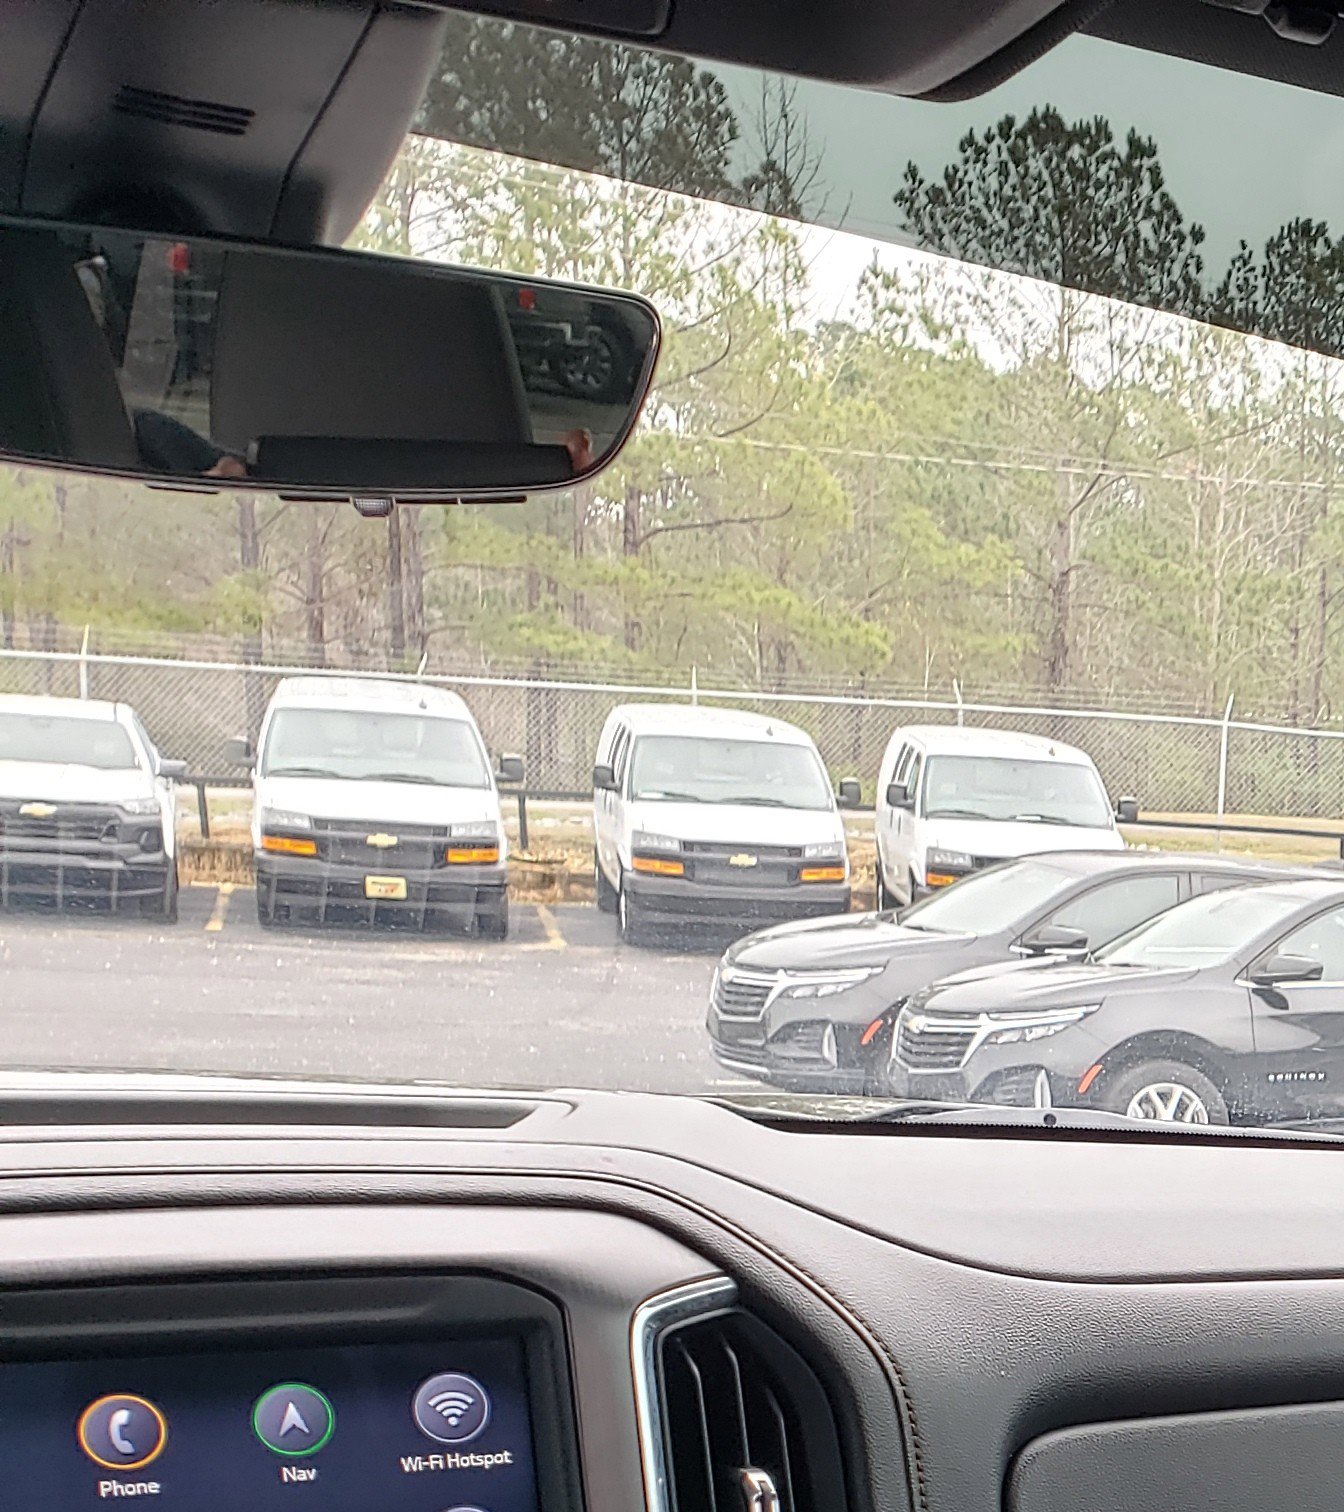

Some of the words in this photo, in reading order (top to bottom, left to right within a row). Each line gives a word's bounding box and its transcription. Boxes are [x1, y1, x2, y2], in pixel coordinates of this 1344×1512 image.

[400, 1454, 445, 1473] Wi-Fi
[447, 1450, 513, 1469] Hotspot
[281, 1466, 317, 1483] Nav
[99, 1479, 161, 1498] Phone
